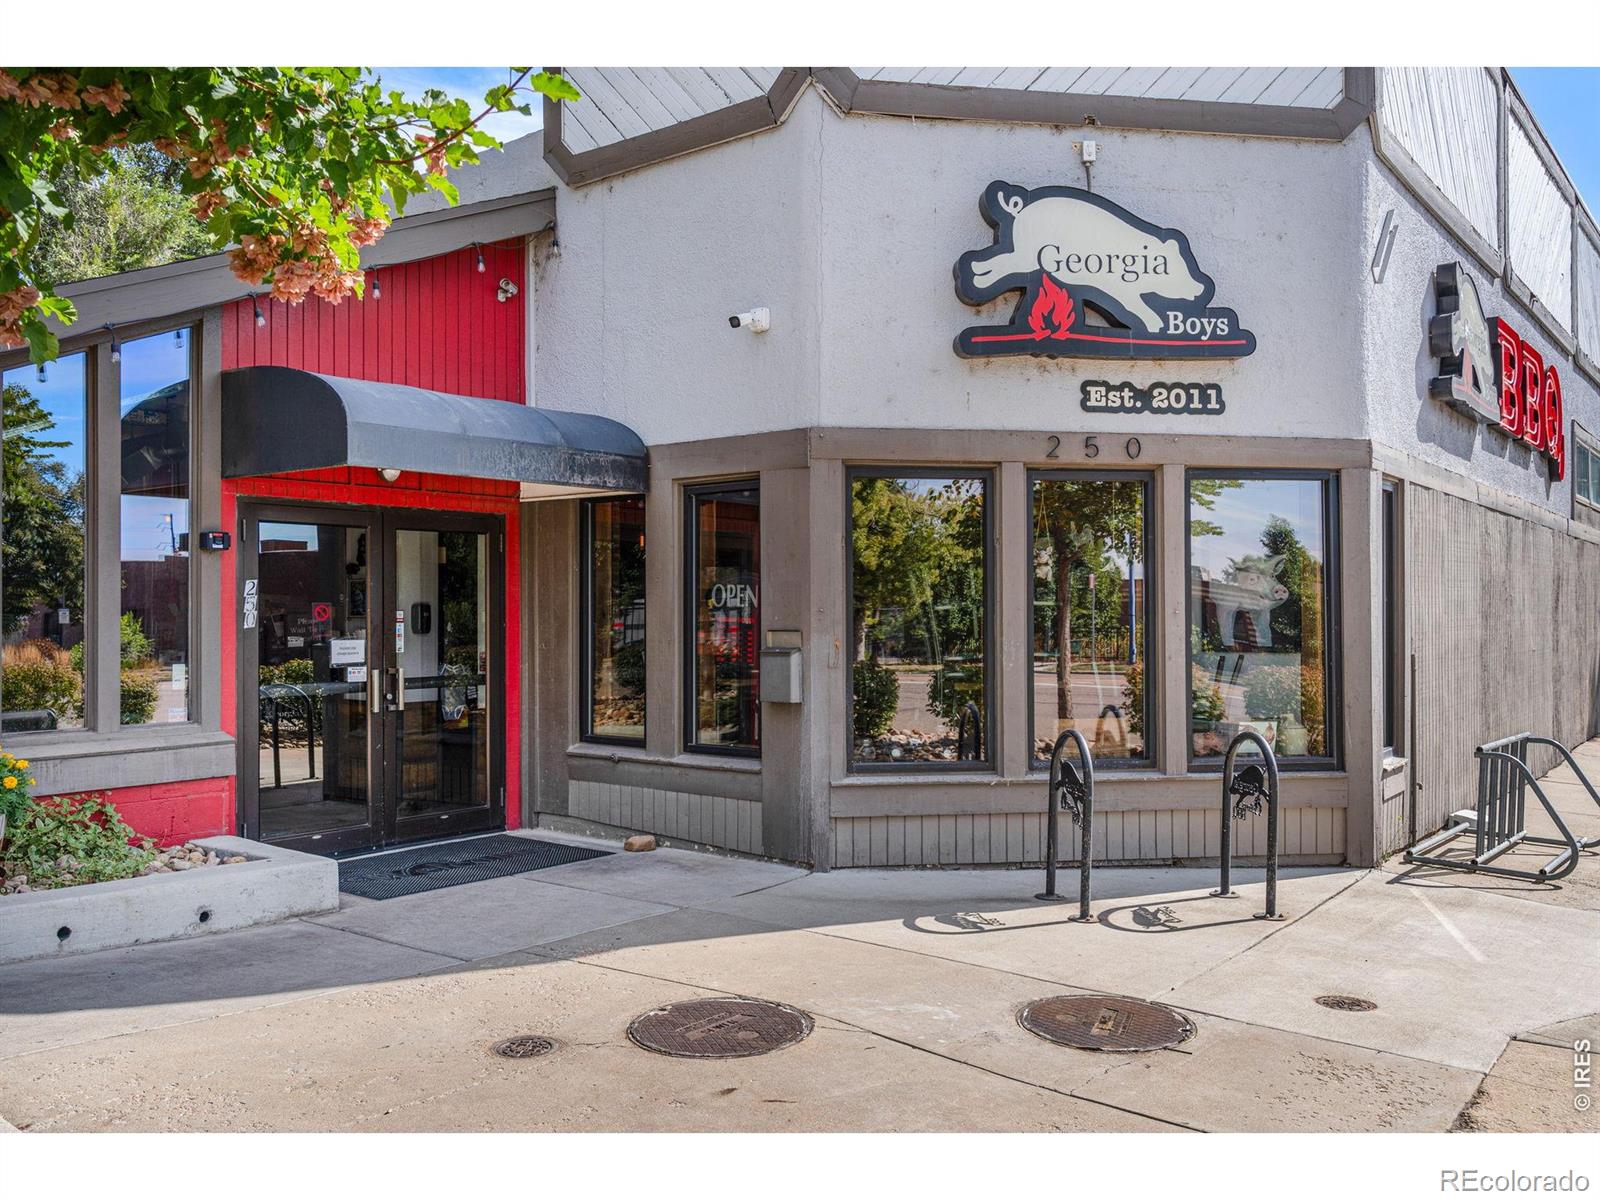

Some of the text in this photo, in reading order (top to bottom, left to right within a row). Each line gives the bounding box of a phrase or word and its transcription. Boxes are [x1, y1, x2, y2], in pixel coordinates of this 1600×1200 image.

[1037, 244, 1169, 282] Georgia
[1166, 311, 1229, 340] Boys
[1086, 386, 1220, 410] Est. 2011
[1494, 316, 1565, 482] BBQ
[245, 580, 256, 627] 250
[711, 583, 759, 608] OPEN
